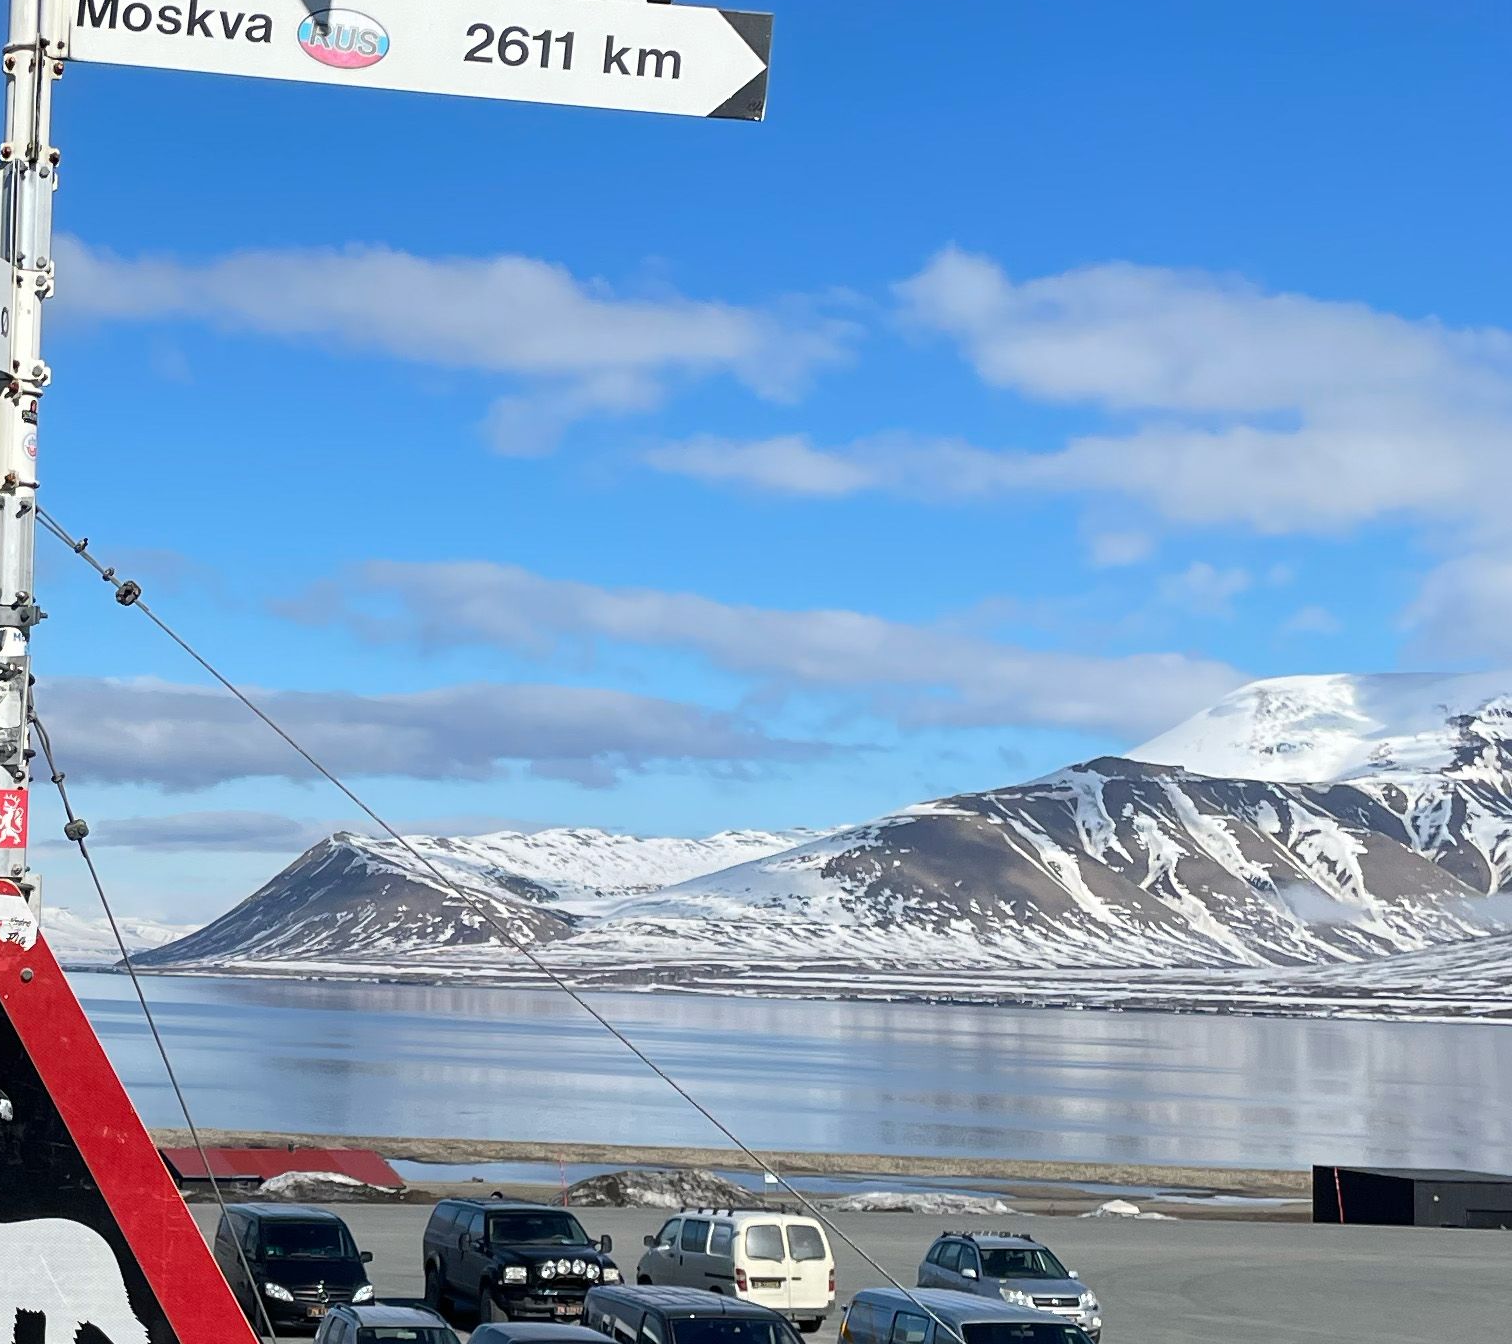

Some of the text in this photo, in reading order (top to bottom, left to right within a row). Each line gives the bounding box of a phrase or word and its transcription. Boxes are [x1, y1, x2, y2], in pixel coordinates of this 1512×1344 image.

[309, 21, 380, 57] RUS
[463, 22, 576, 70] 2611
[603, 34, 682, 80] km
